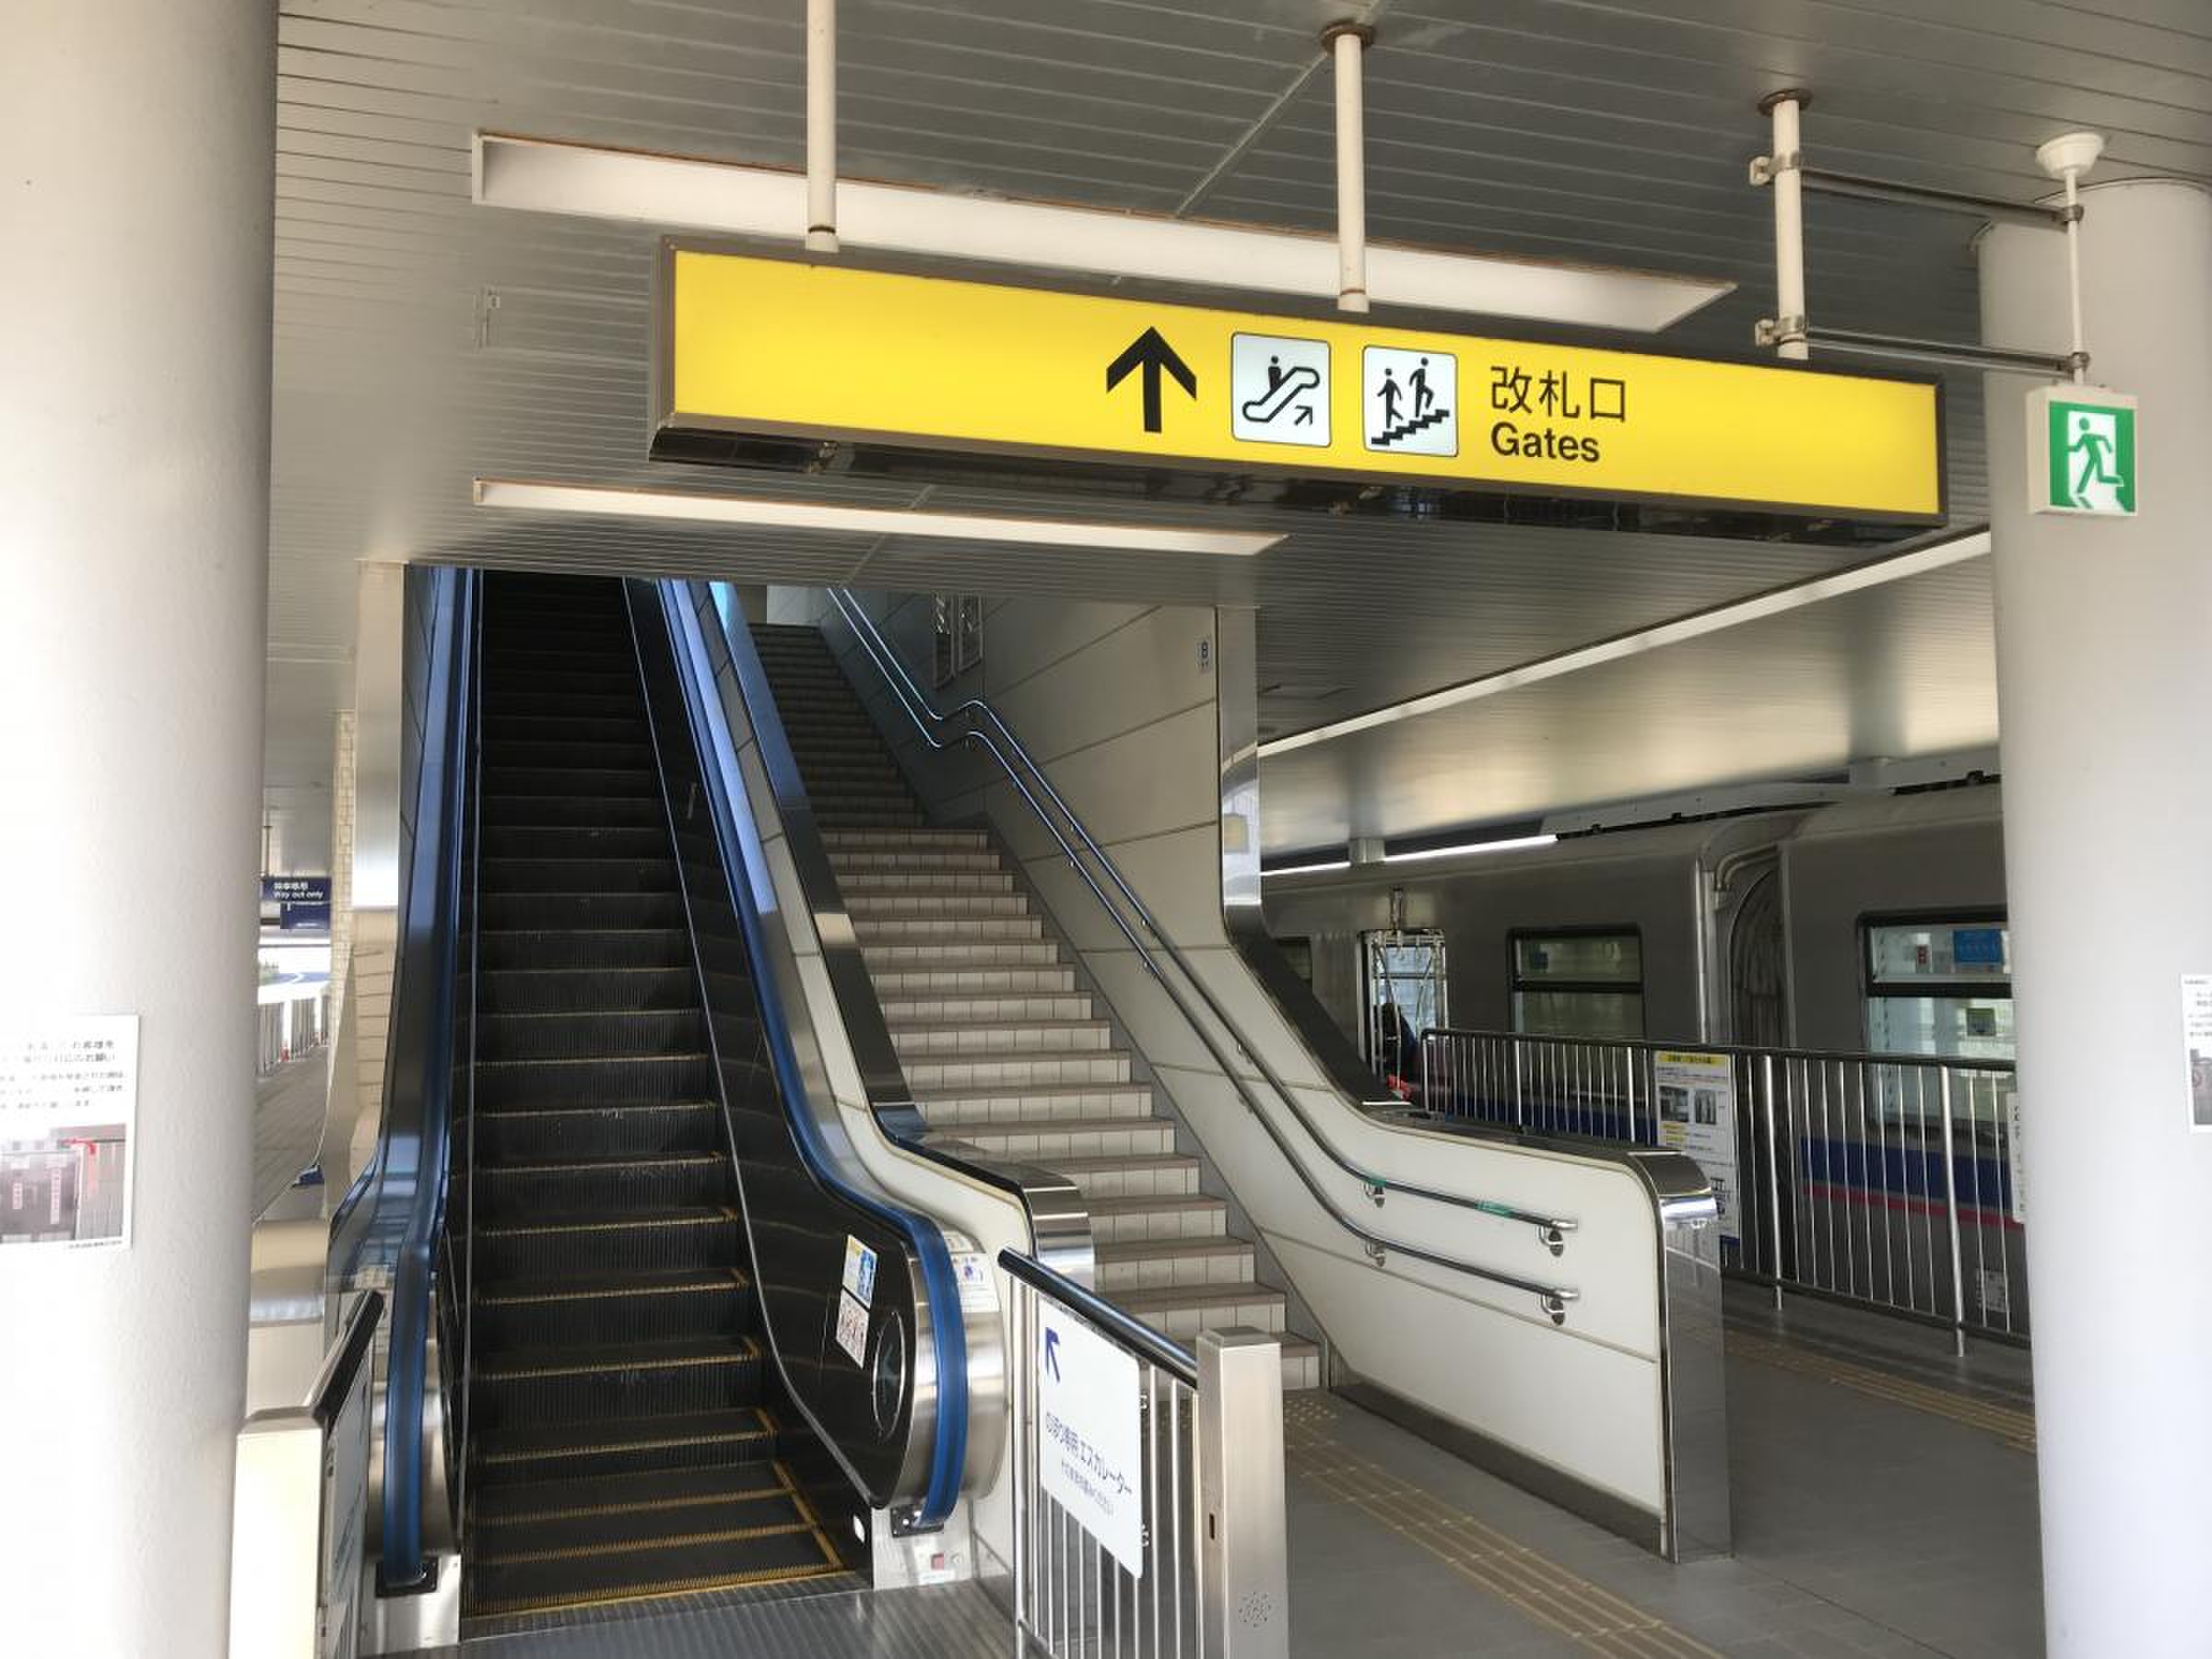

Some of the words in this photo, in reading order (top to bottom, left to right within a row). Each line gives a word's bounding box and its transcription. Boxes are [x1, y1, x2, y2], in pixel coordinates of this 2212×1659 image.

[1490, 365, 1627, 423] 改札口
[1490, 420, 1601, 463] Gates
